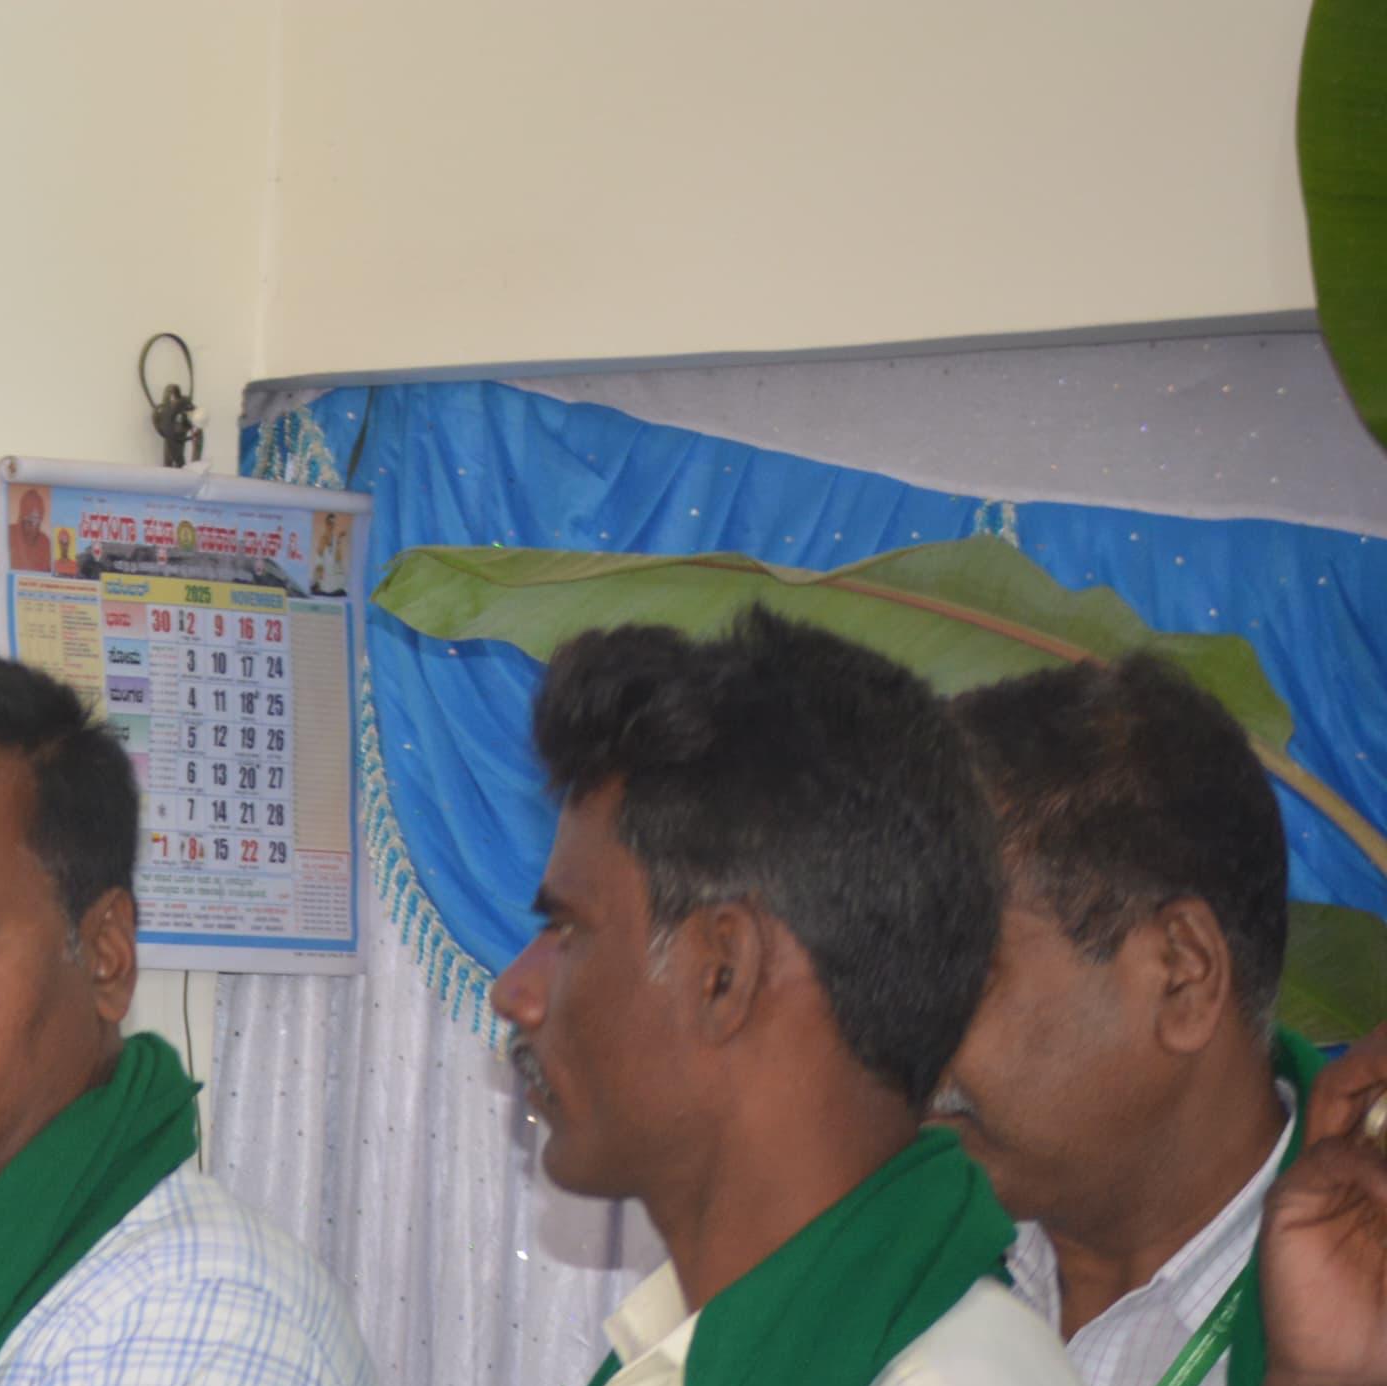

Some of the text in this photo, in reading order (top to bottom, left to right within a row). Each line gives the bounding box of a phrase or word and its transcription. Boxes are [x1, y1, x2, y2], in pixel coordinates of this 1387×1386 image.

[184, 585, 212, 604] 2025
[230, 590, 284, 609] NOVEMBER
[151, 609, 171, 633] 30
[187, 612, 196, 635] 2
[214, 614, 224, 637] 9
[238, 617, 254, 640] 16
[265, 618, 282, 642] 23
[187, 649, 196, 673] 3
[211, 652, 227, 675] 10
[240, 656, 254, 678] 17
[266, 656, 284, 679] 24
[187, 687, 196, 709] 4
[213, 689, 226, 712] 11
[240, 691, 254, 714] 18
[267, 693, 284, 716] 25
[187, 726, 196, 749] 5
[213, 725, 227, 748] 12
[240, 726, 255, 749] 19
[267, 728, 284, 751] 26
[187, 761, 196, 784] 6
[212, 763, 227, 785] 13
[239, 766, 256, 790] 20
[268, 766, 284, 789] 27
[188, 798, 195, 821] 7
[212, 800, 227, 822] 14
[240, 802, 255, 825] 21
[267, 803, 284, 826] 28
[161, 834, 168, 857] 1
[188, 837, 197, 861] 8
[213, 838, 229, 861] 15
[240, 839, 258, 863] 22
[268, 841, 287, 864] 29
